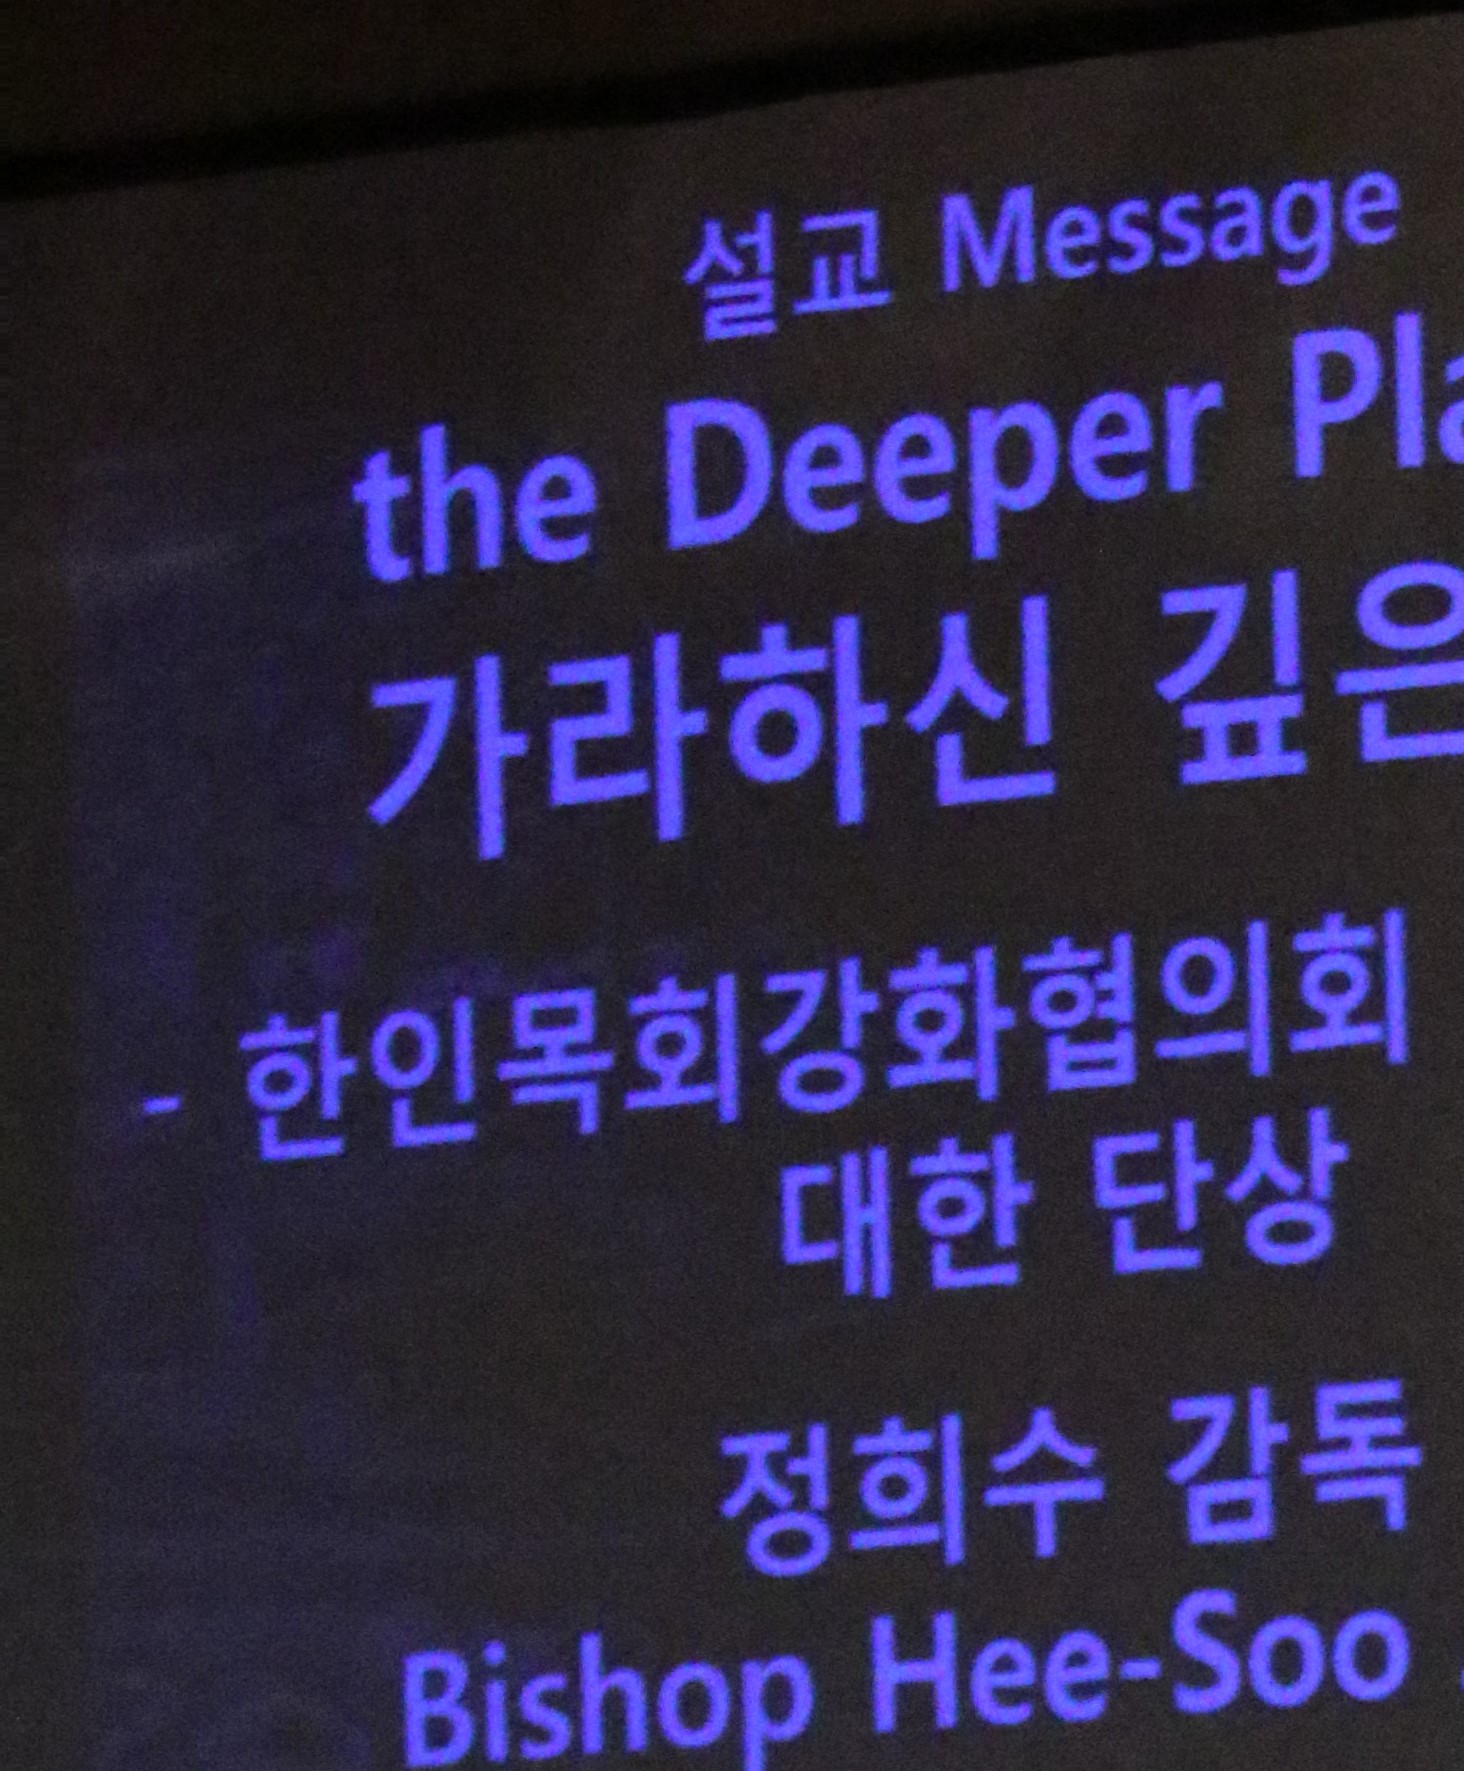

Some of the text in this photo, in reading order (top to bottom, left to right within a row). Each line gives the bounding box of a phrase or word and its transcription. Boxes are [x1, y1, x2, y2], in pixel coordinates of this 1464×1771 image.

[685, 171, 1399, 340] 설교 Message
[352, 424, 596, 582] the
[666, 382, 1223, 559] Deeper
[369, 595, 1056, 859] 가라하신
[240, 909, 1408, 1161] 한인목회강화협의회
[781, 1107, 1349, 1298] 대한 단상
[721, 1379, 1422, 1576] 정희수 감독
[871, 1589, 1410, 1732] Hee-Soo
